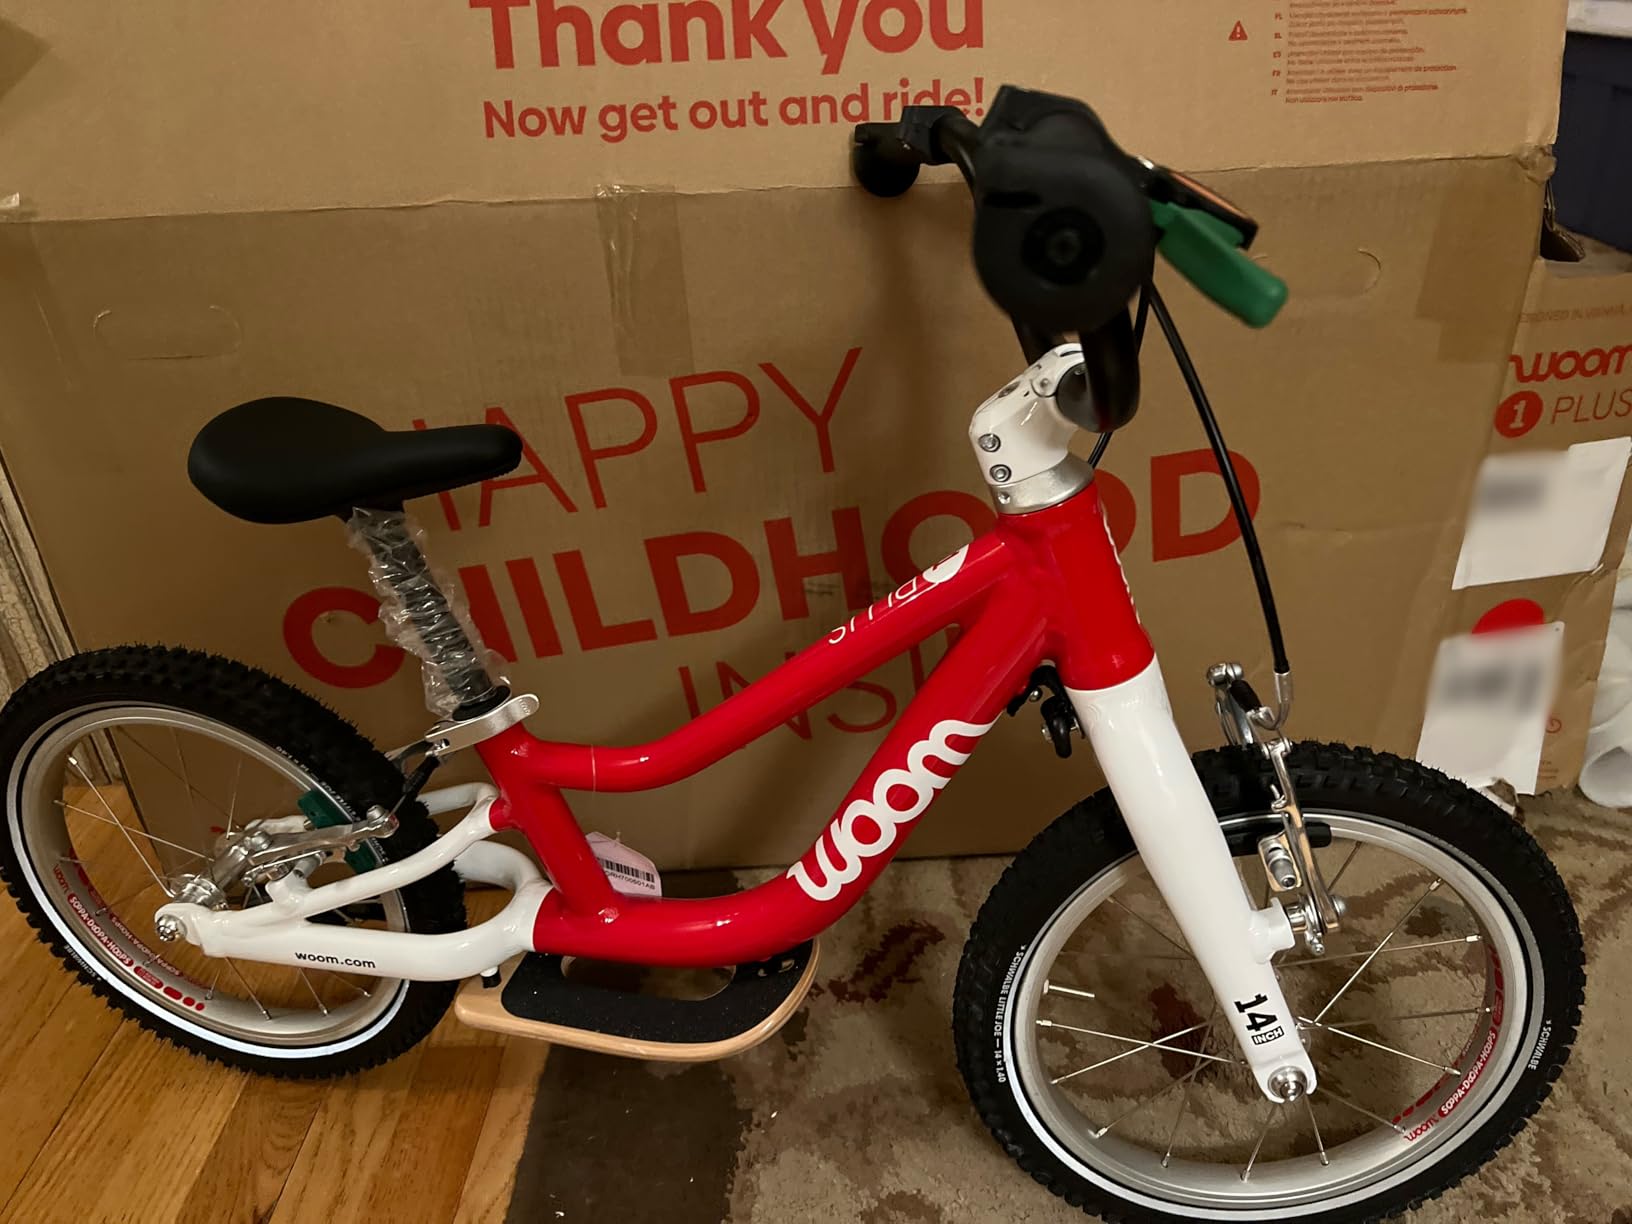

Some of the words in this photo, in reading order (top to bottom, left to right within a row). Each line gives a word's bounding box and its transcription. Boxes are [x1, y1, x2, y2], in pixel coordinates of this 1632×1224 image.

[469, 0, 788, 70] Thank
[804, 0, 984, 75] you
[483, 99, 587, 139] Now
[598, 95, 677, 144] get
[689, 91, 767, 130] out
[778, 84, 869, 126] and
[883, 77, 984, 121] ride!
[1551, 388, 1632, 425] PLUS
[412, 346, 862, 531] APPY
[786, 712, 1005, 902] woom
[294, 951, 376, 969] woom.com
[1000, 951, 1025, 996] SCHWALBE
[1234, 994, 1278, 1032] 14
[1252, 1027, 1284, 1044] INCH
[1527, 1025, 1552, 1071] SCHWALBE
